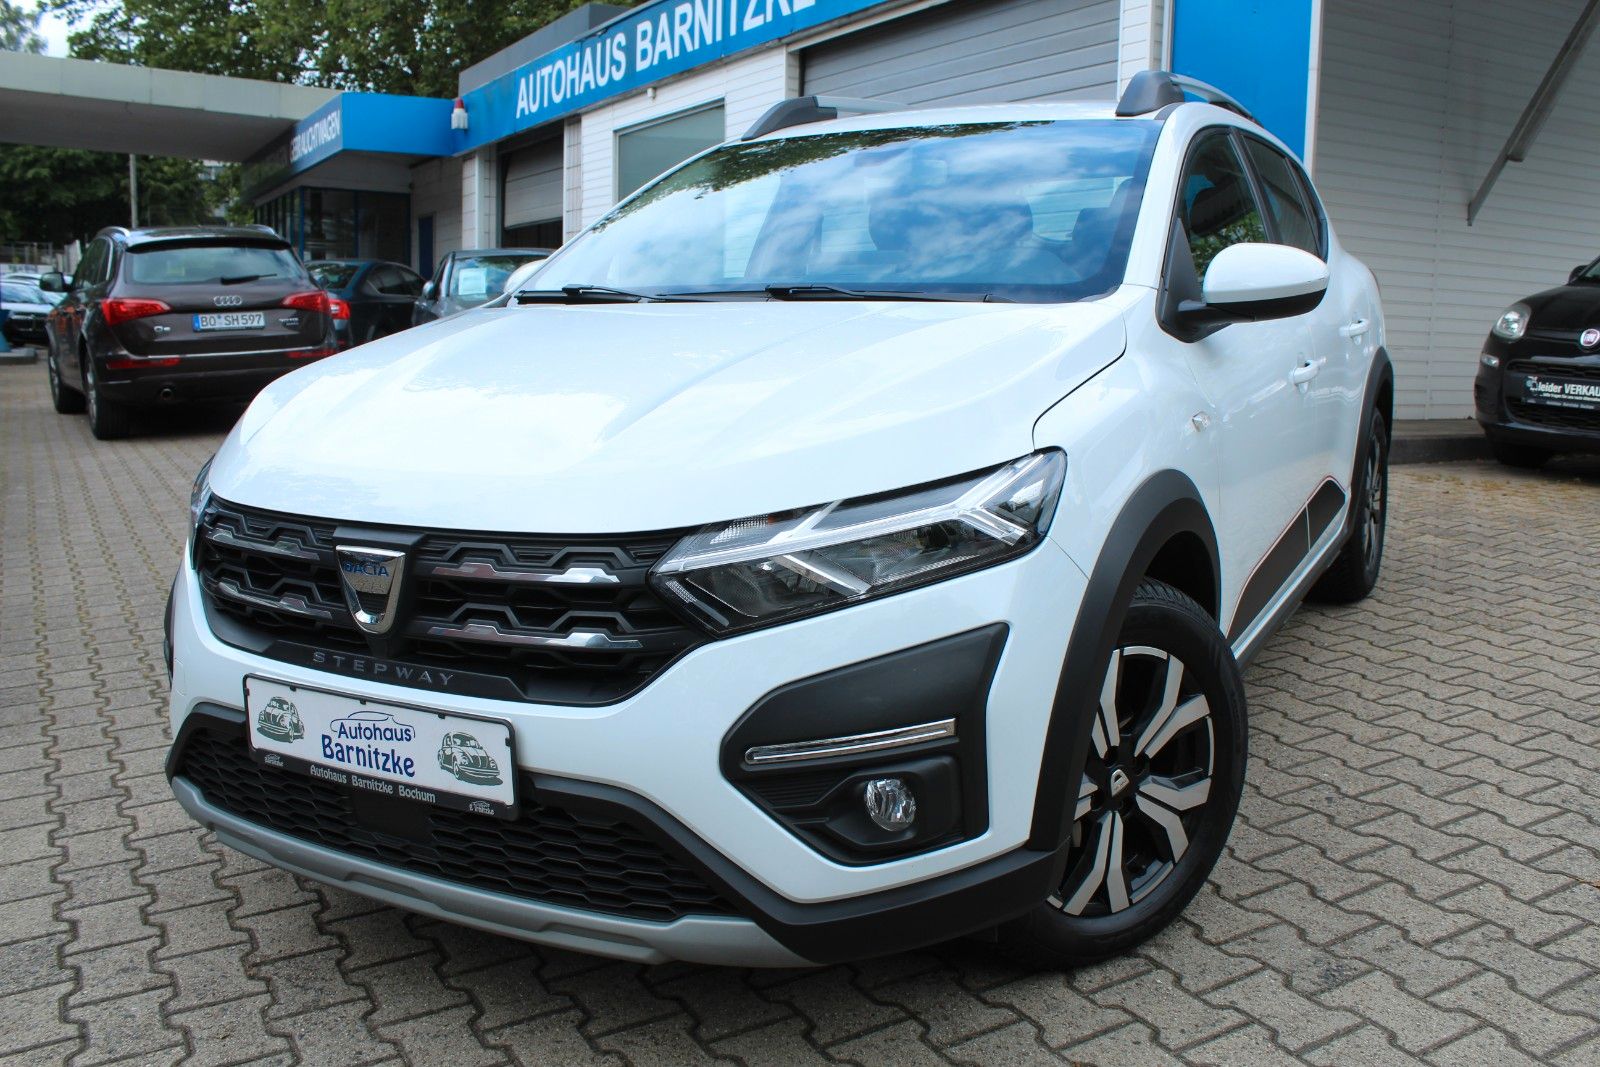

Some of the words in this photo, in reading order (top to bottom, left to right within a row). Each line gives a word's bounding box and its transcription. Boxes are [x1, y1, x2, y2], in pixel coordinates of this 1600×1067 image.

[515, 32, 627, 119] AUTOHAUS
[635, 0, 816, 73] BARNITZ
[200, 315, 217, 327] BO
[312, 651, 454, 686] STEPWAY
[338, 721, 412, 742] Autohaus
[321, 733, 416, 778] Barnitzke
[310, 764, 347, 784] Autohaus
[351, 775, 394, 795] Barnitzke
[398, 785, 436, 804] Bochum
